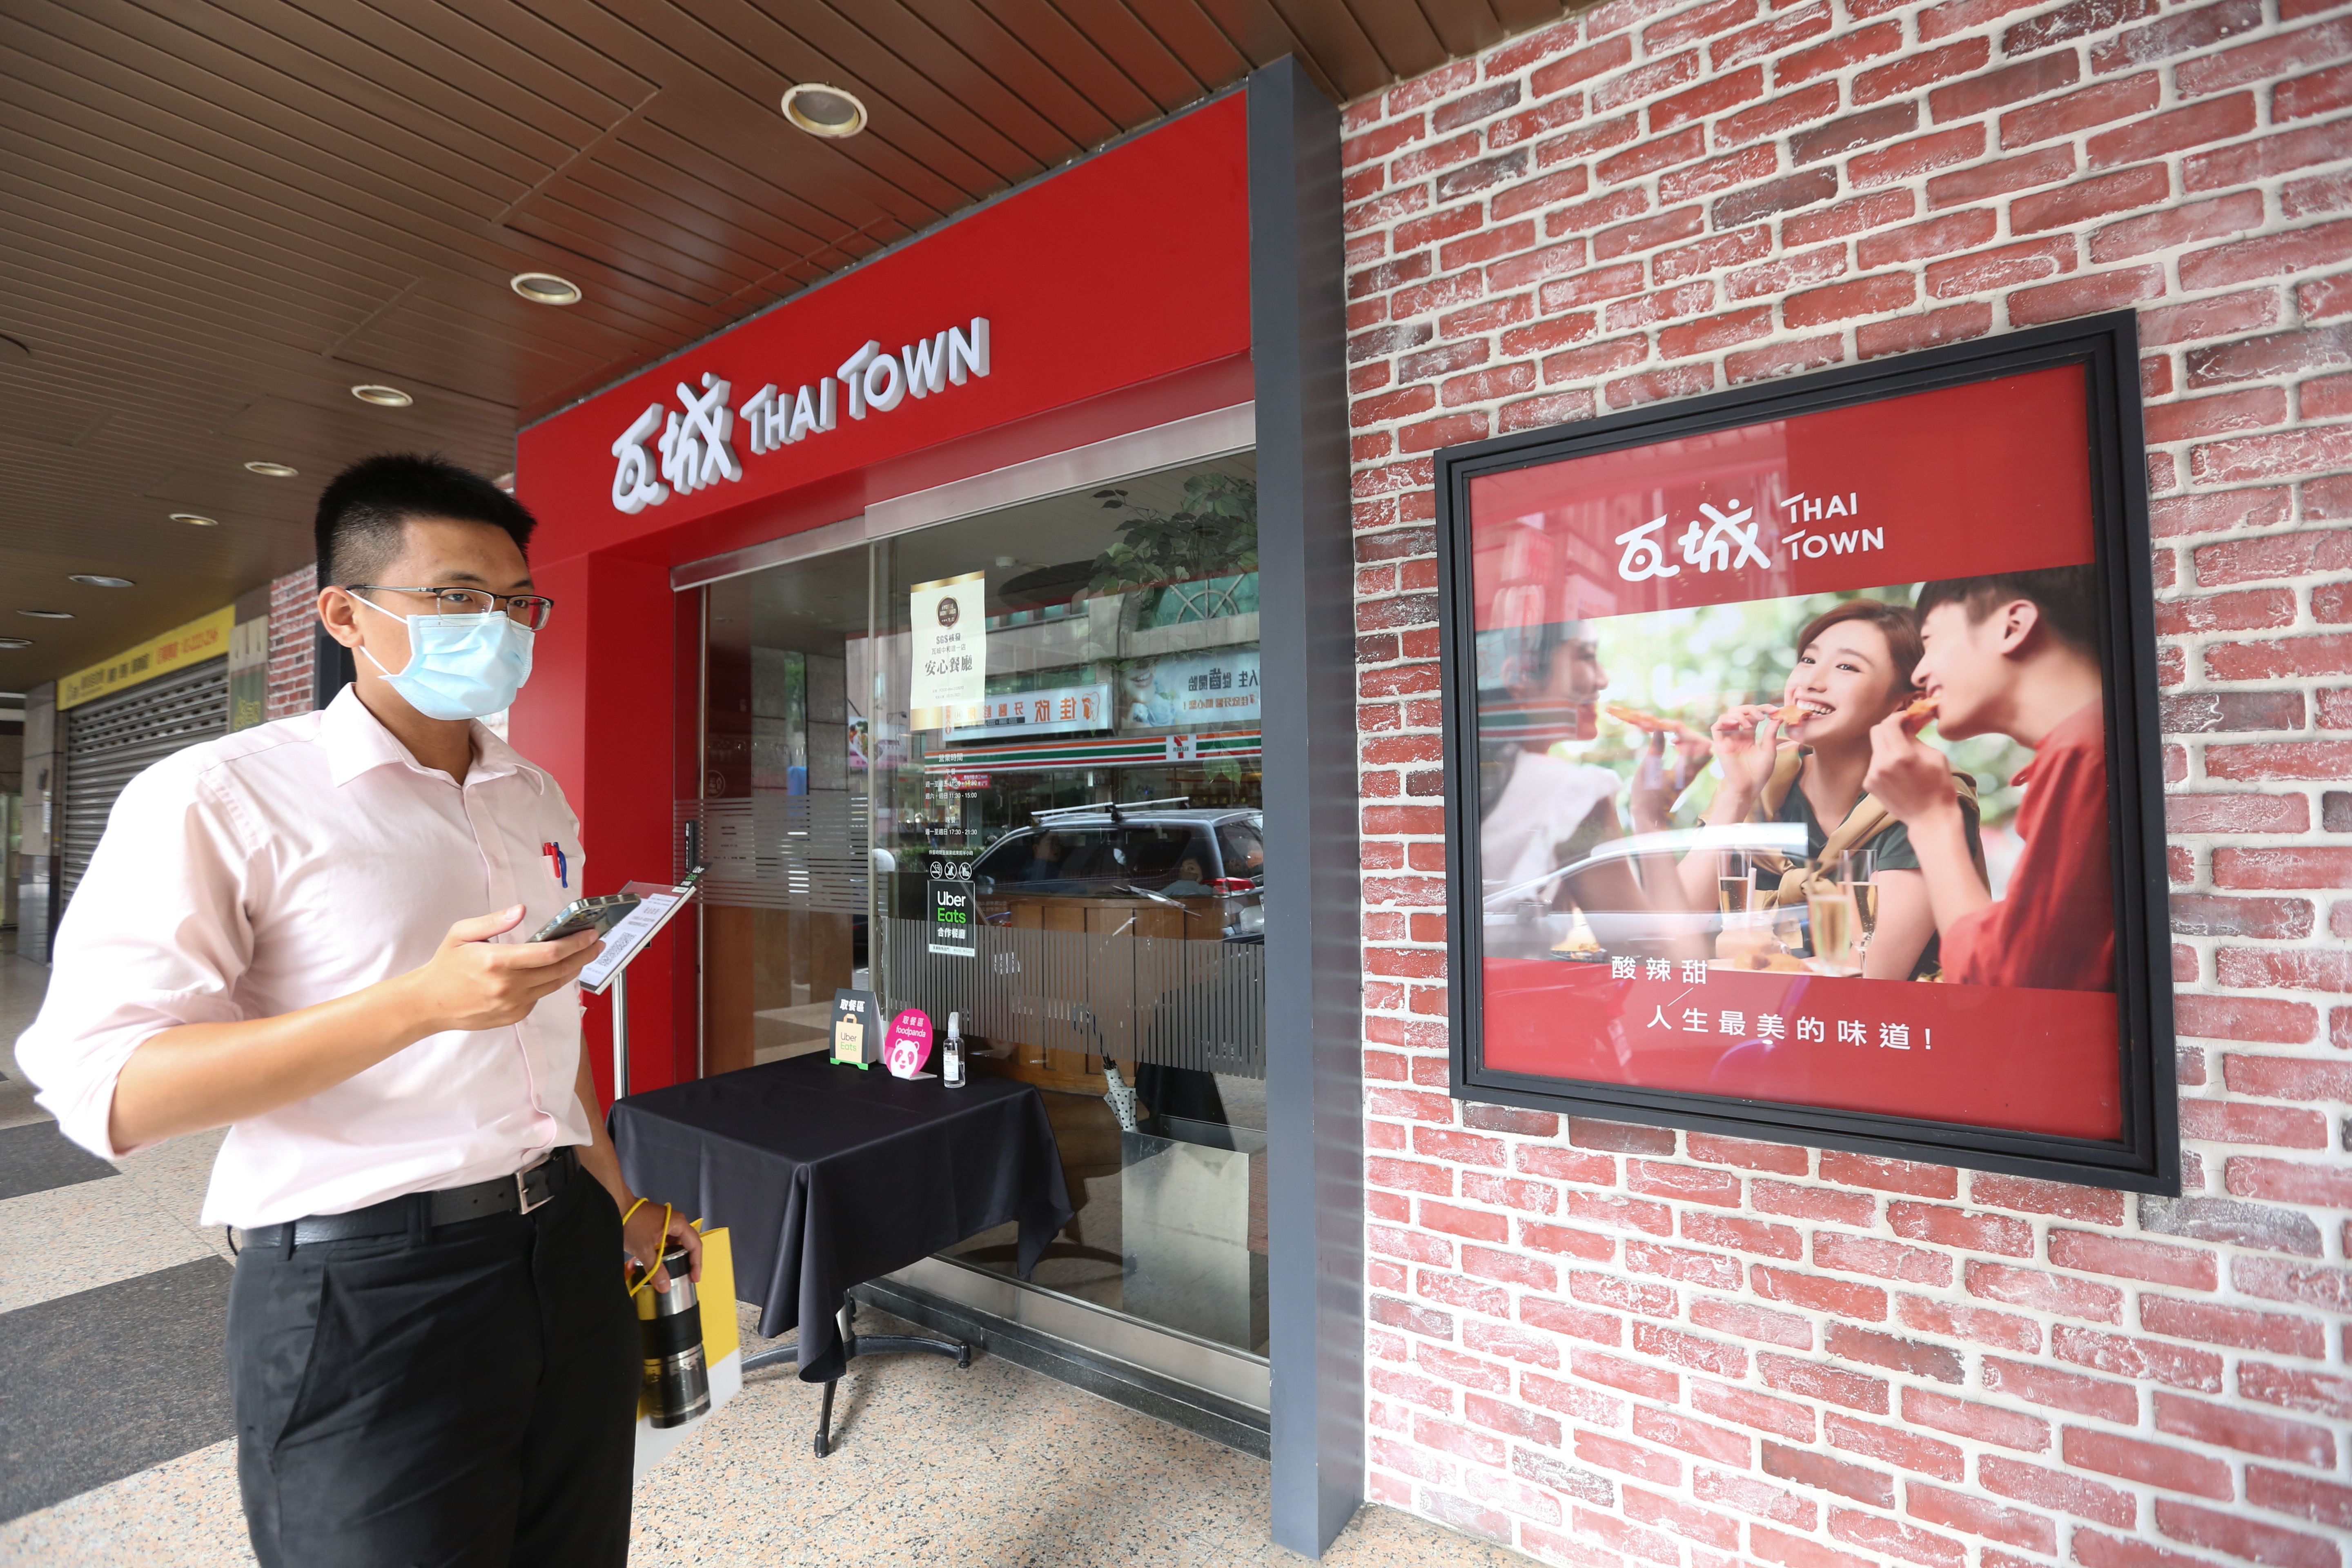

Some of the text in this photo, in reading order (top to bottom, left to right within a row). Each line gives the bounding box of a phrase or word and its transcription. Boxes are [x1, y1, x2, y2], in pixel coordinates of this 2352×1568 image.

[611, 316, 990, 515] 瓦城 THAI TOWN
[1780, 491, 1858, 524] THAI
[1614, 498, 1772, 582] 瓦城
[1781, 526, 1885, 561] TOWN
[924, 655, 973, 677] 安心餐廳
[938, 753, 963, 763] 營業時間
[937, 890, 966, 907] Uber
[937, 907, 966, 924] Eats
[1610, 955, 1708, 985] 酸辣甜
[839, 998, 866, 1013] 取餐區
[902, 1015, 924, 1027] 取餐區
[840, 1032, 857, 1042] Uber
[895, 1026, 927, 1038] foodpanda
[840, 1042, 857, 1051] Eats
